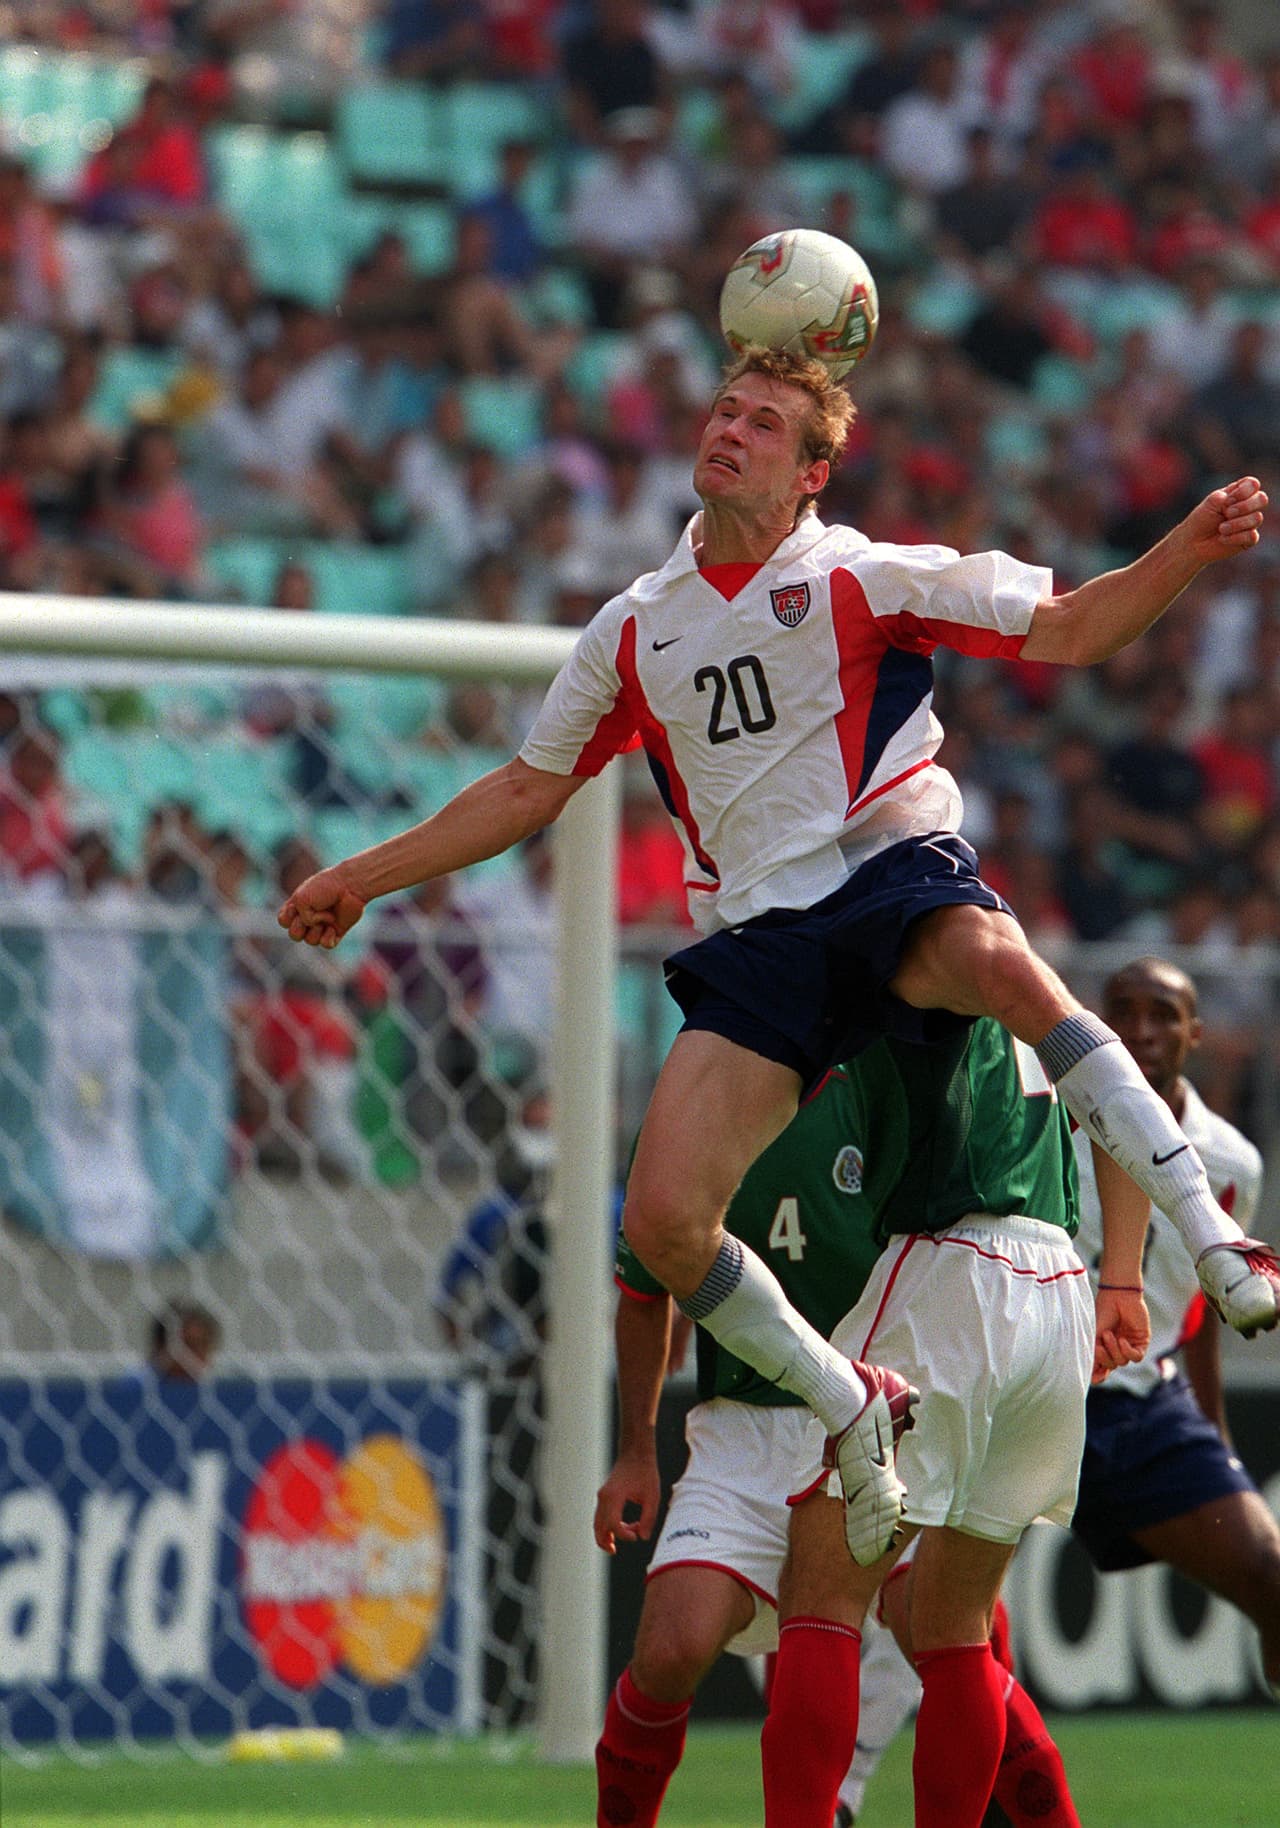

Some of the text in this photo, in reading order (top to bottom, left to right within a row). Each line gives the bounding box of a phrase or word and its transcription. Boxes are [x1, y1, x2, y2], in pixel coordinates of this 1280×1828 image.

[693, 654, 777, 745] 20
[768, 1196, 807, 1261] 4
[0, 1449, 227, 1685] ard
